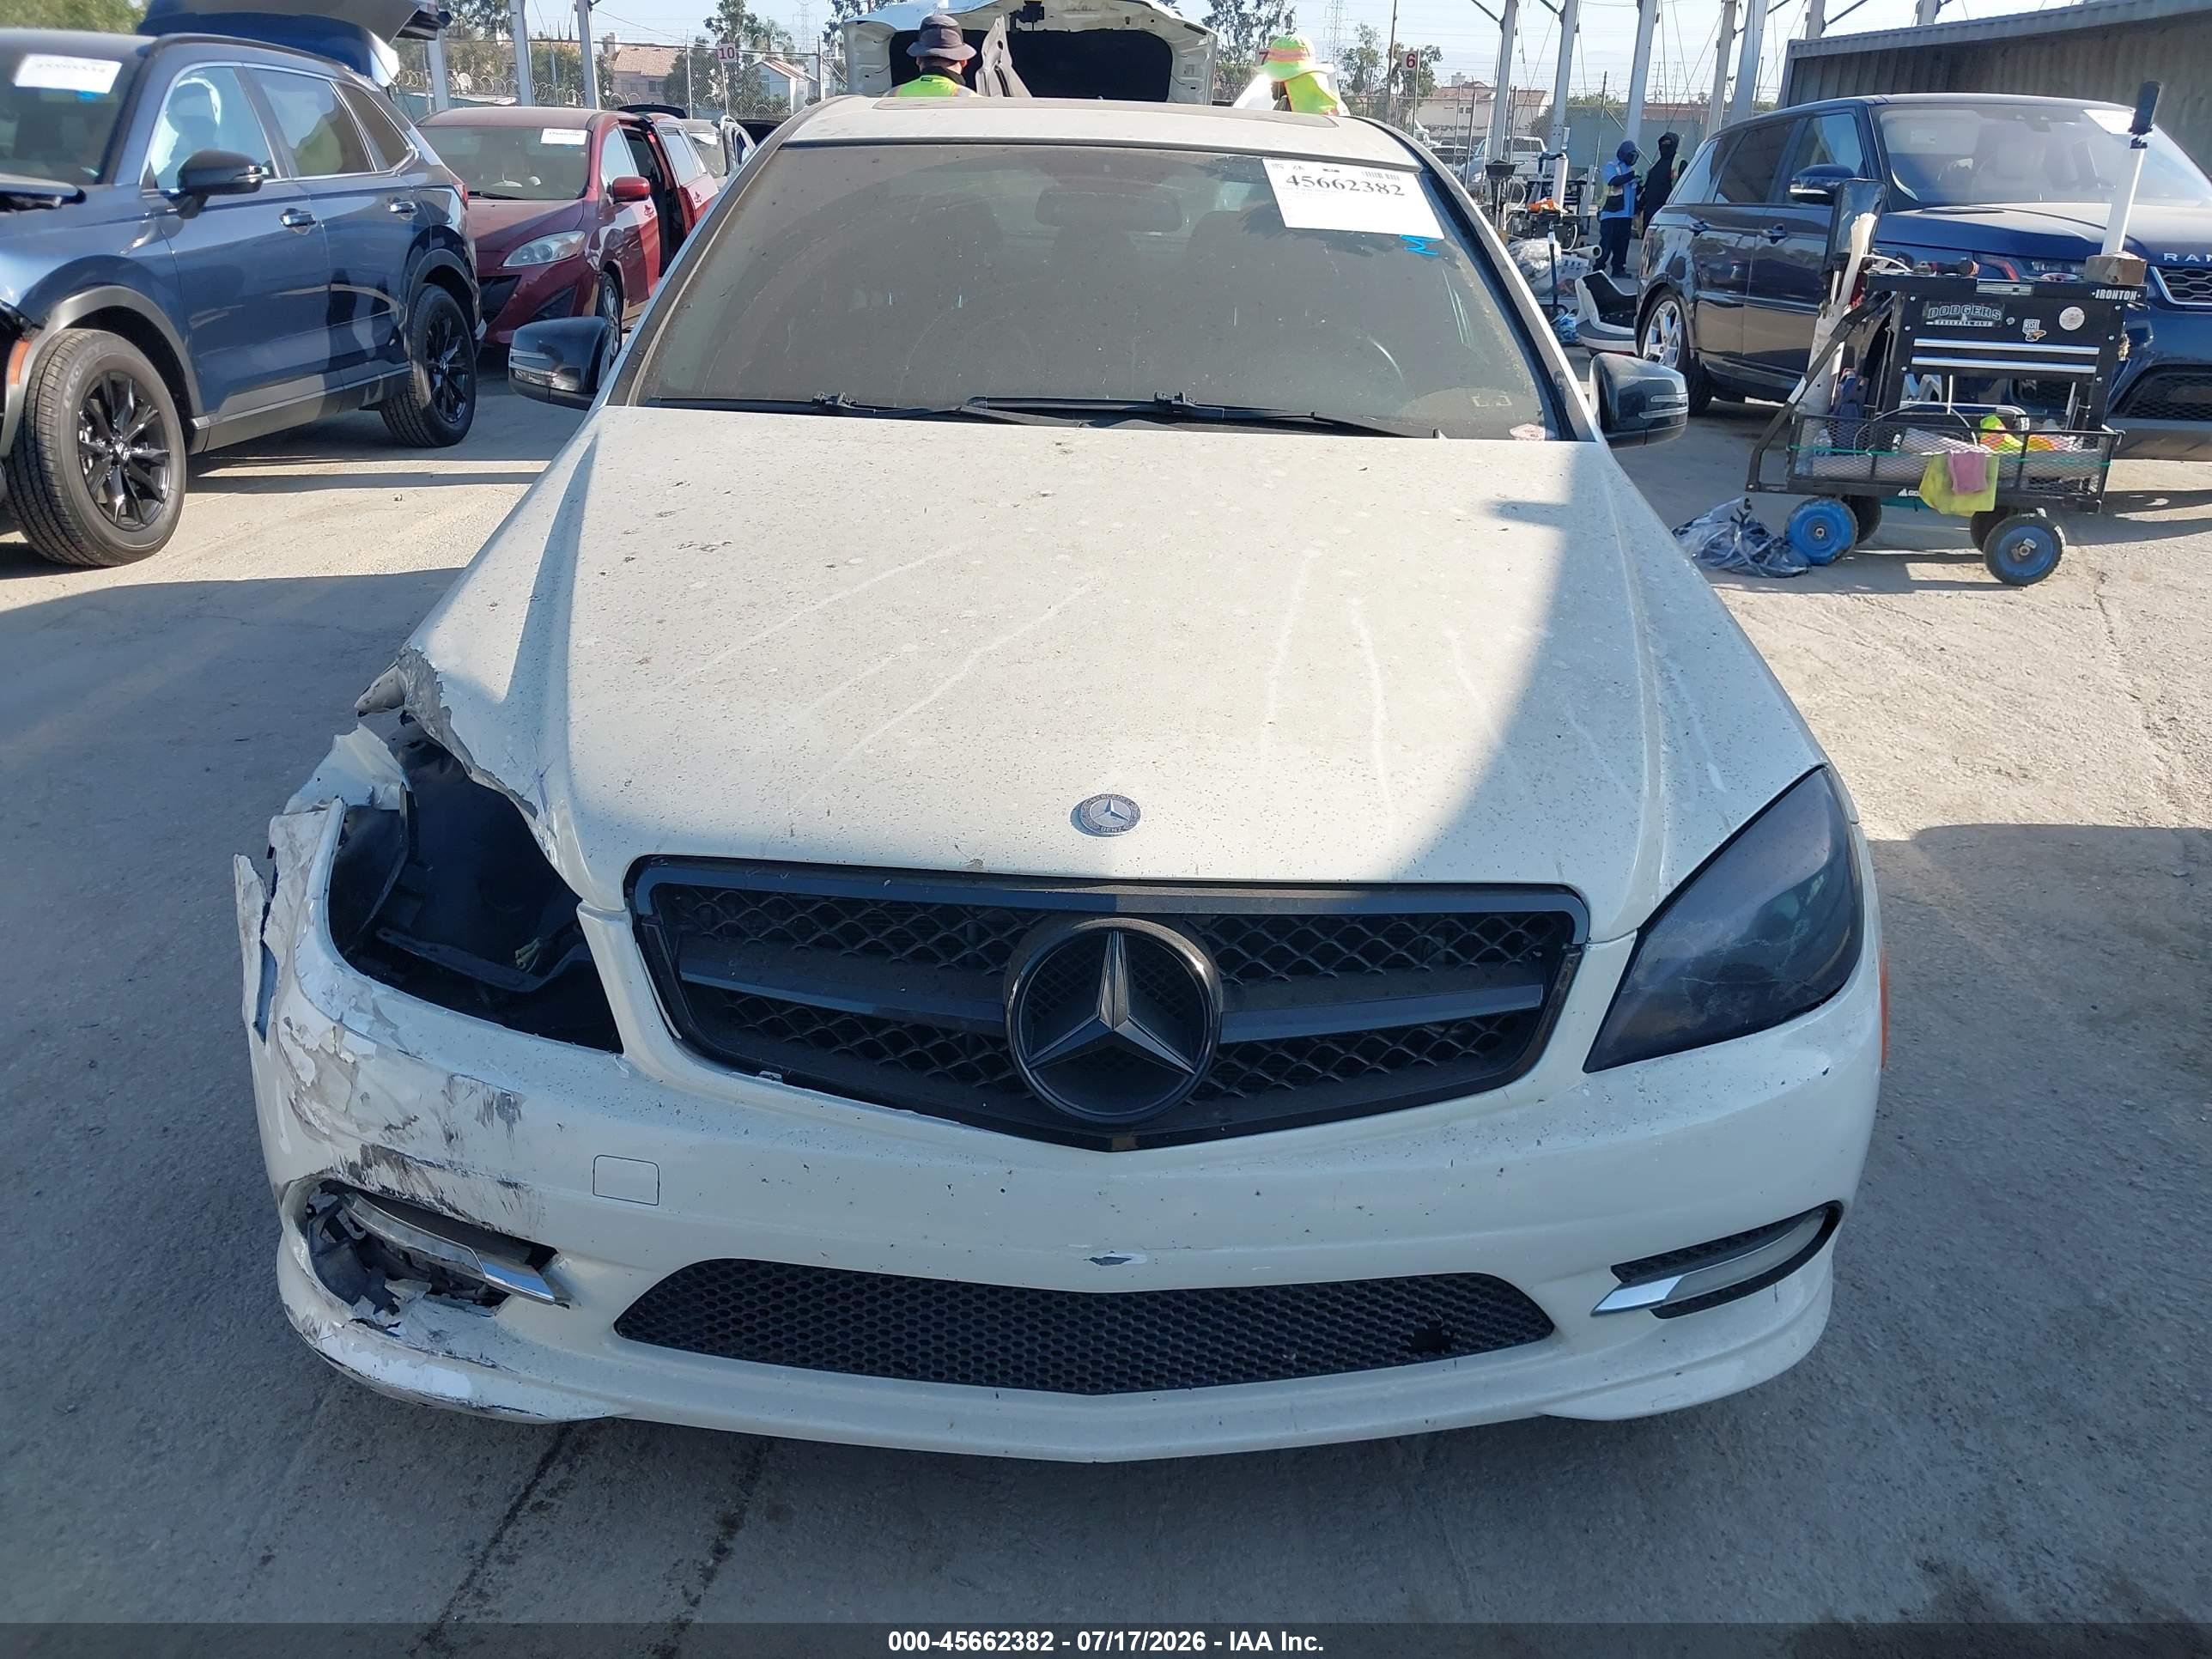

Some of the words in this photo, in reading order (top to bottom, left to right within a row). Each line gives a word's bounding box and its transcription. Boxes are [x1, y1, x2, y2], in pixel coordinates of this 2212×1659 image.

[719, 46, 735, 60] 10
[1406, 53, 1416, 69] 6
[1285, 174, 1405, 196] 45662382
[2095, 289, 2137, 301] IRONTON
[1927, 304, 2002, 321] DODGERS
